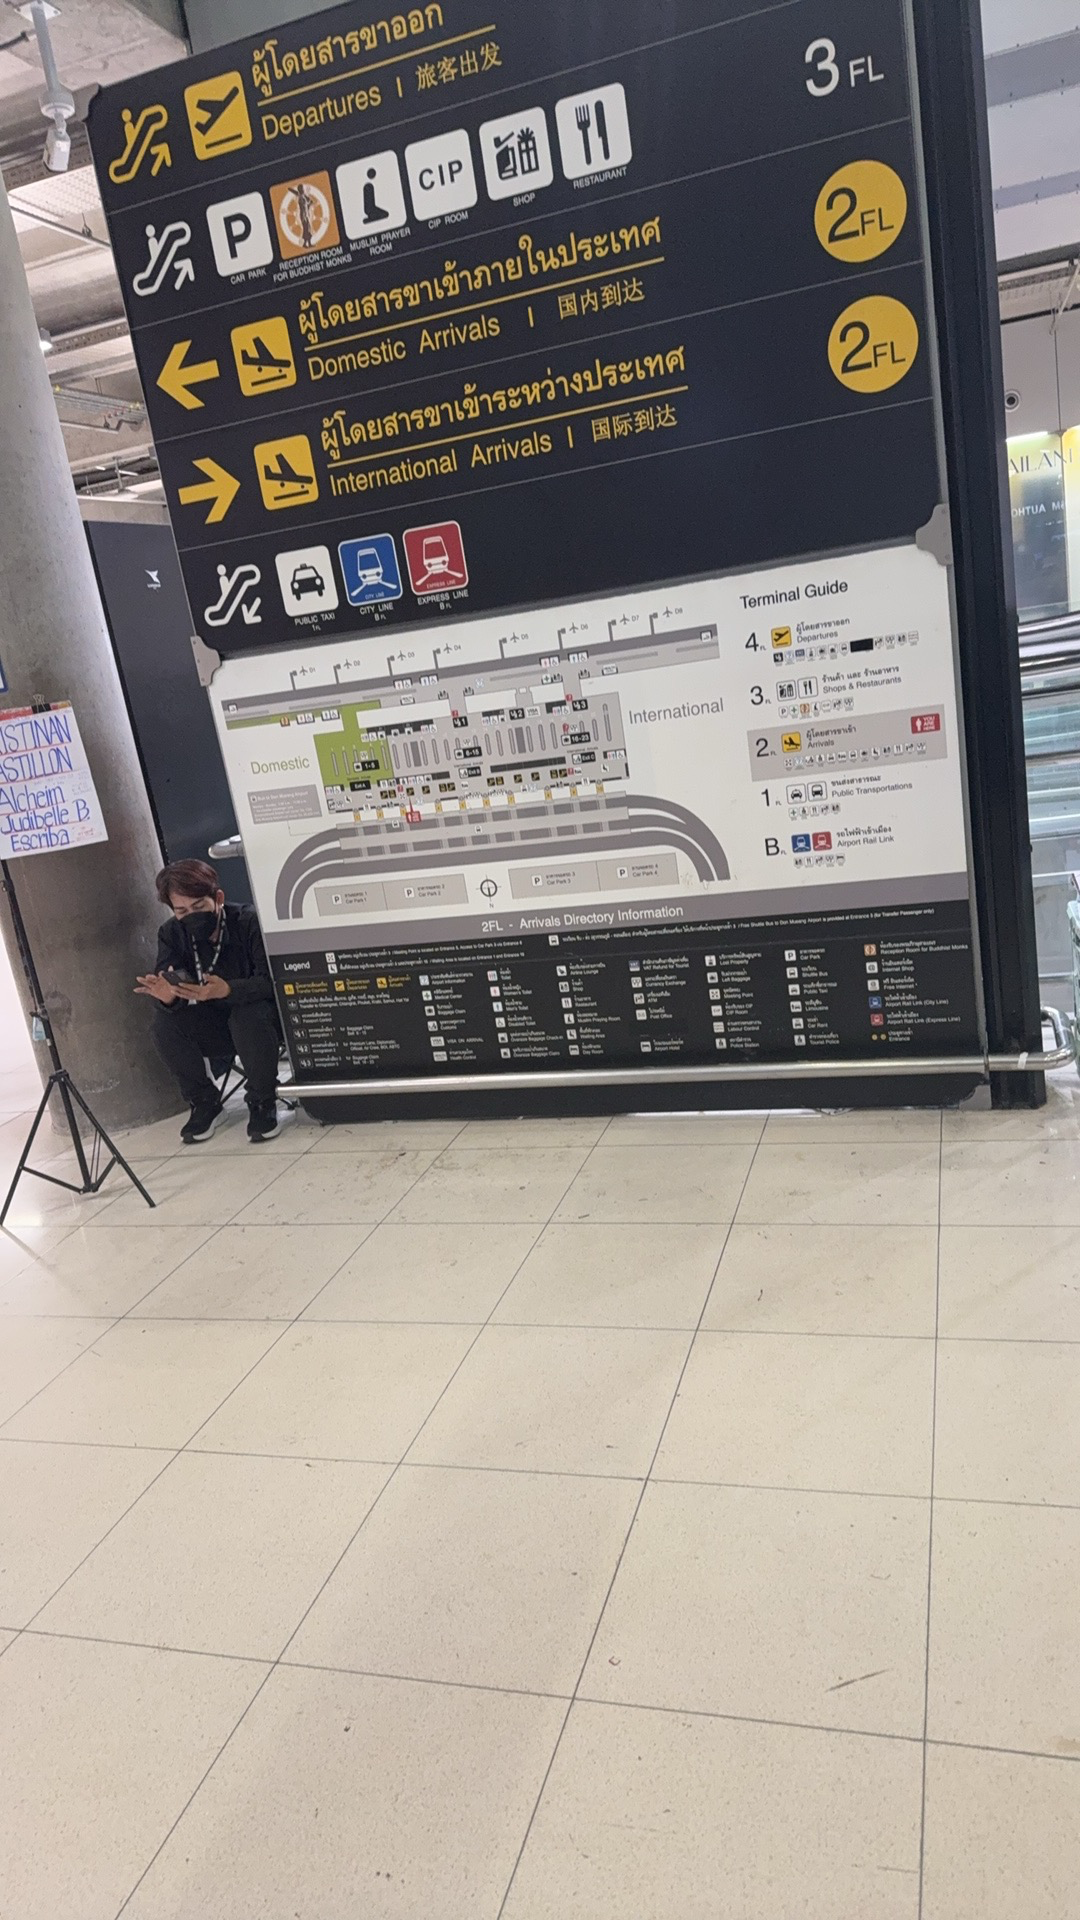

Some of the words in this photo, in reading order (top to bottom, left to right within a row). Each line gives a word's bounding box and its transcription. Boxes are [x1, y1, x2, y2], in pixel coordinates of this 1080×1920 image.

[252, 2, 444, 97] ผู้โดยสารขาออก
[415, 43, 502, 92] 旅客出发
[804, 38, 840, 97] 3
[849, 55, 884, 87] FL
[260, 84, 382, 141] Departures
[418, 159, 463, 190] CIP
[573, 167, 627, 190] RESTAURANT
[513, 193, 536, 207] SHOP
[428, 219, 441, 230] CIP
[444, 211, 469, 225] ROOM
[223, 212, 251, 260] P
[350, 237, 378, 252] MUSLIM
[381, 227, 411, 244] PRAYER
[279, 253, 320, 271] RECEPTION
[320, 246, 343, 260] ROOM
[369, 243, 393, 256] ROOM
[230, 273, 245, 285] CAR
[248, 269, 267, 281] PARK
[273, 271, 288, 283] FOR
[289, 263, 325, 280] BUDDHIST
[326, 254, 352, 271] MONKS
[299, 216, 662, 345] ผู้โดยสารขาเข้าภายในประเทศ
[558, 277, 644, 320] 国内到达
[308, 338, 406, 382] Domestic
[419, 315, 501, 356] Arrivals
[321, 345, 686, 461] ผู้โดยสารขาเข้าระหว่างประเทศ
[591, 405, 678, 443] 国际到达
[329, 449, 458, 498] International
[470, 429, 552, 471] Arrivals
[426, 581, 445, 589] EXPRESS
[739, 587, 800, 609] Terminal
[805, 580, 848, 598] Guide
[360, 605, 375, 615] CITY
[378, 602, 394, 612] LINE
[417, 593, 450, 606] EXPRESS
[452, 590, 469, 599] LINE
[294, 615, 319, 626] PUBLIC
[321, 612, 336, 621] TAXI
[797, 630, 839, 644] Departures
[823, 683, 847, 694] Shops
[848, 681, 855, 690] &
[856, 675, 902, 690] Restaurants
[629, 698, 724, 725] International
[0, 714, 72, 755] ISTINAN
[807, 738, 835, 749] Arrivals
[250, 755, 310, 775] Domestic
[832, 787, 854, 798] Public
[856, 782, 913, 796] Transportations
[0, 805, 69, 836] Judibelle
[11, 828, 70, 852] Escriba
[837, 837, 861, 849] Airport
[862, 836, 878, 846] Rail
[879, 835, 894, 844] Link
[481, 921, 503, 933] 2FL
[520, 917, 561, 930] Arrivals
[564, 910, 615, 928] Directory
[618, 905, 684, 921] Information
[283, 961, 311, 972] Legend
